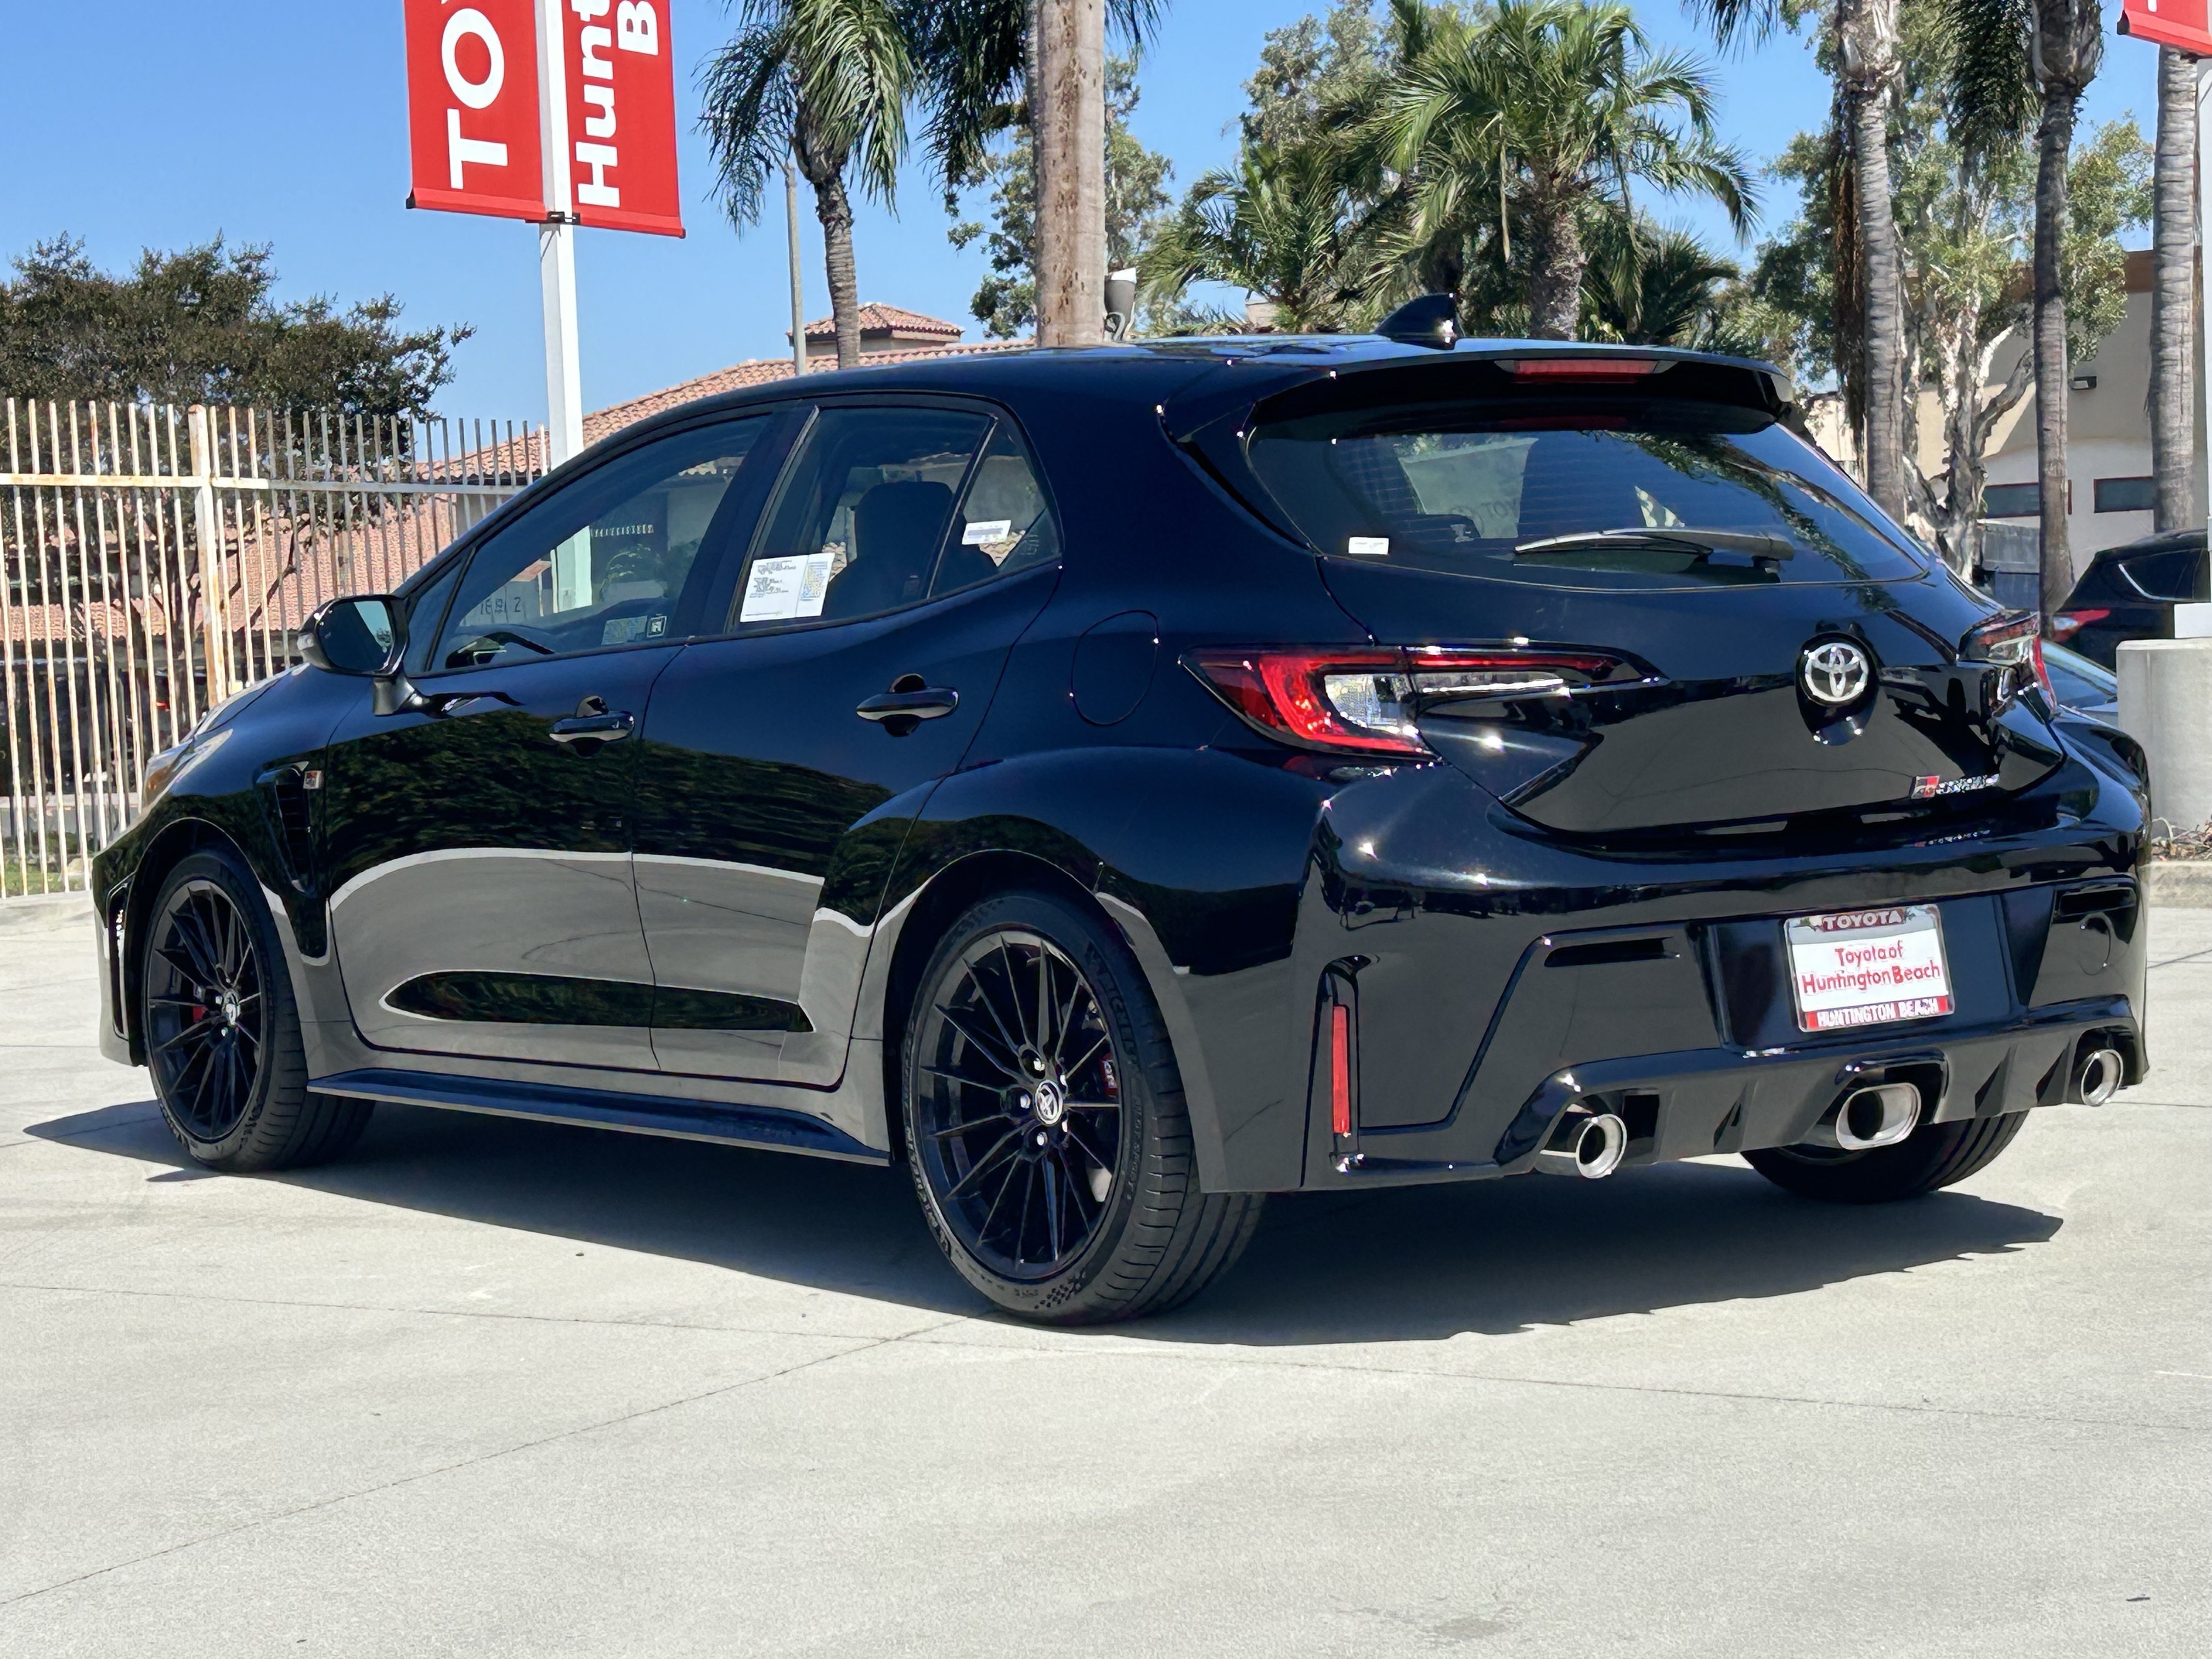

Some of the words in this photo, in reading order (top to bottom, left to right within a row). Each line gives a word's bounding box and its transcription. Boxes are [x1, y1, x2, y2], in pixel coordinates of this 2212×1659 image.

[441, 0, 507, 190] TO
[1822, 910, 1903, 930] TOYOTA
[1834, 945, 1888, 967] Toyota
[1889, 940, 1903, 960] of
[1802, 969, 1892, 994] Huntington
[1892, 960, 1940, 984] Beach
[1816, 1002, 1896, 1028] HUNTINGTON
[1898, 997, 1940, 1019] BEACH
